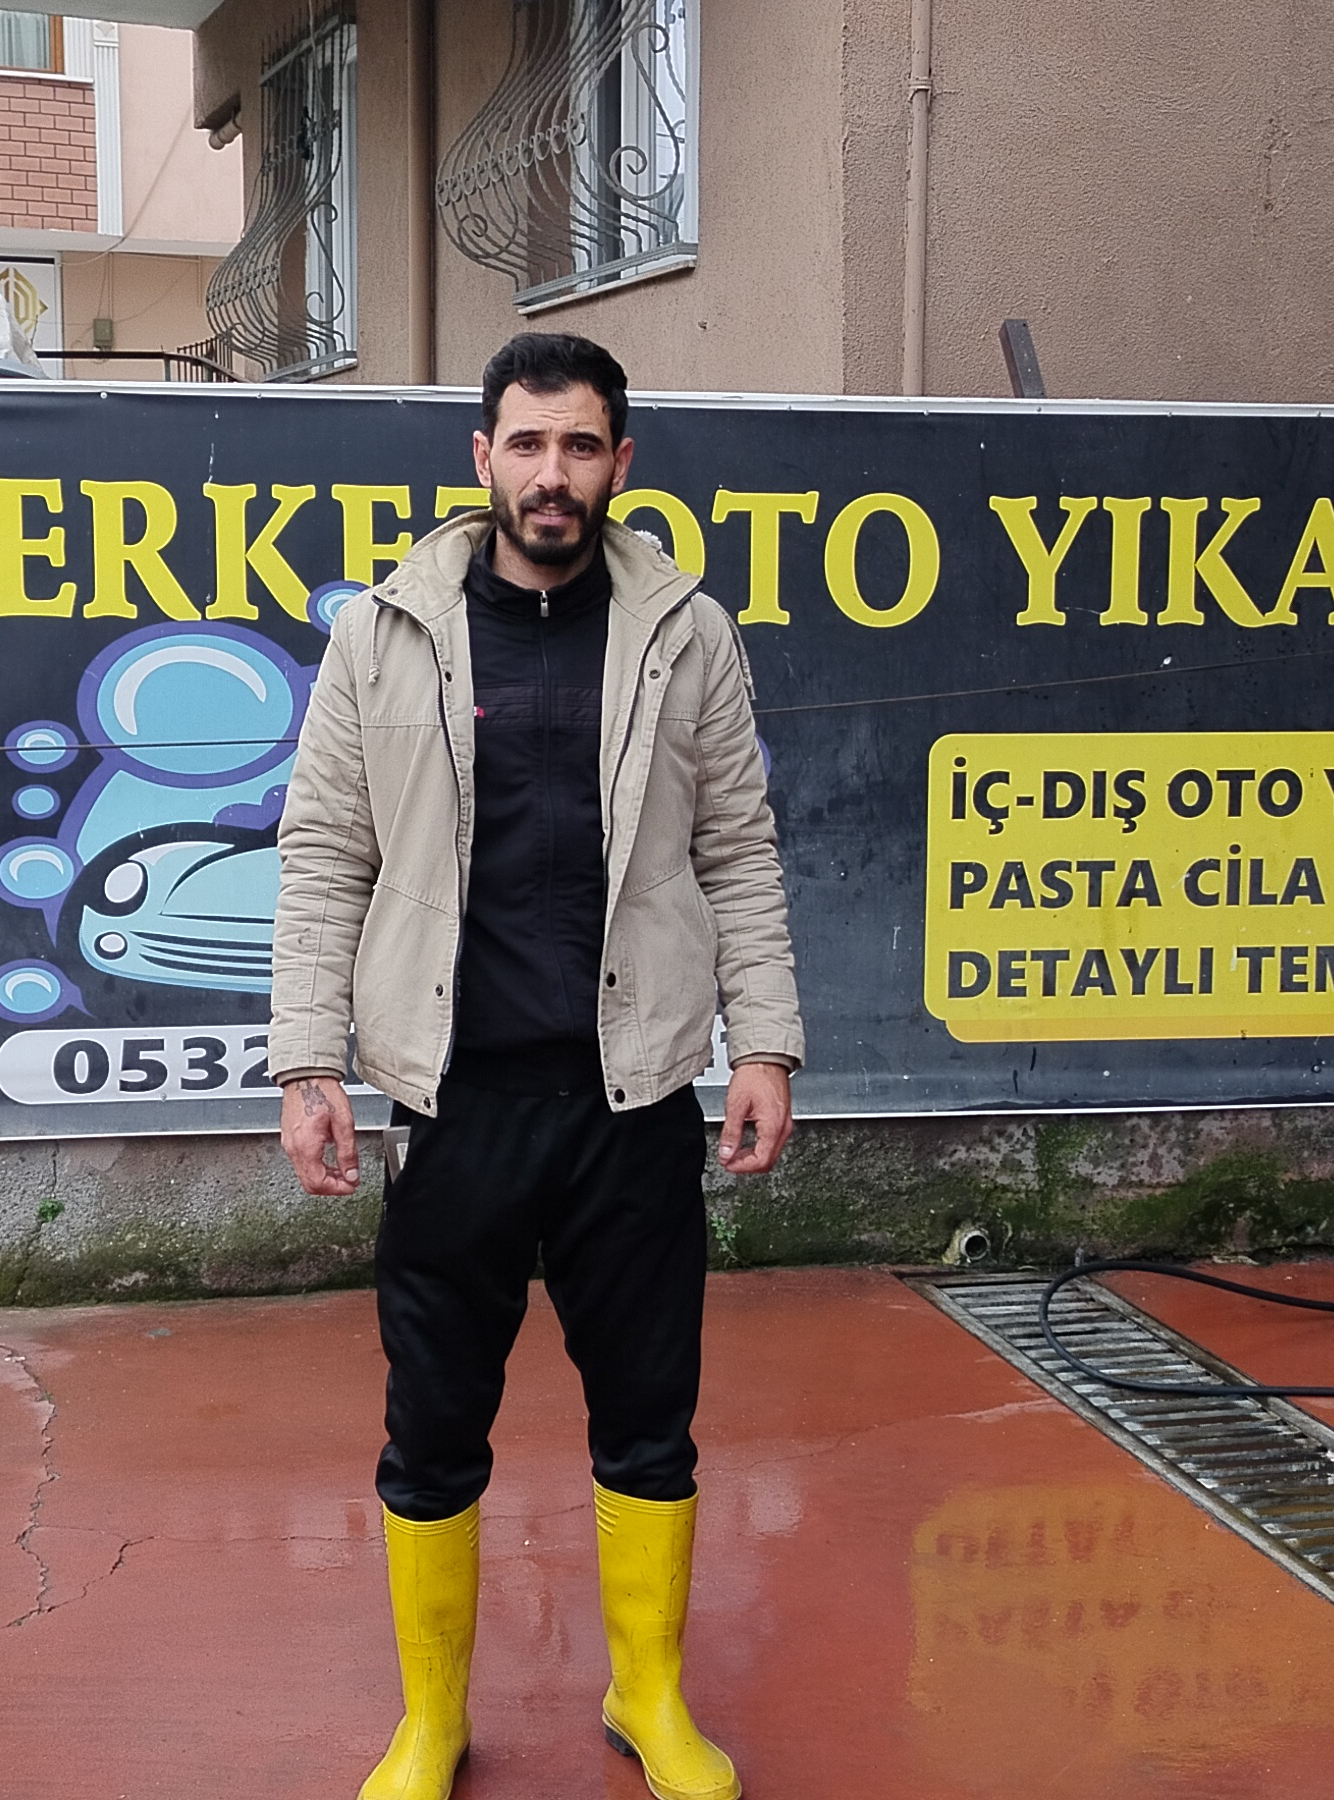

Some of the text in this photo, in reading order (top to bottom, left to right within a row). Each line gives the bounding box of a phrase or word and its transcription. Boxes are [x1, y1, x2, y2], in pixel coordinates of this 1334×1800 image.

[951, 756, 1147, 835] İÇ-DIŞ
[1167, 769, 1303, 819] OTO
[949, 844, 1325, 910] PASTA CİLA
[948, 947, 1214, 999] DETAYLI
